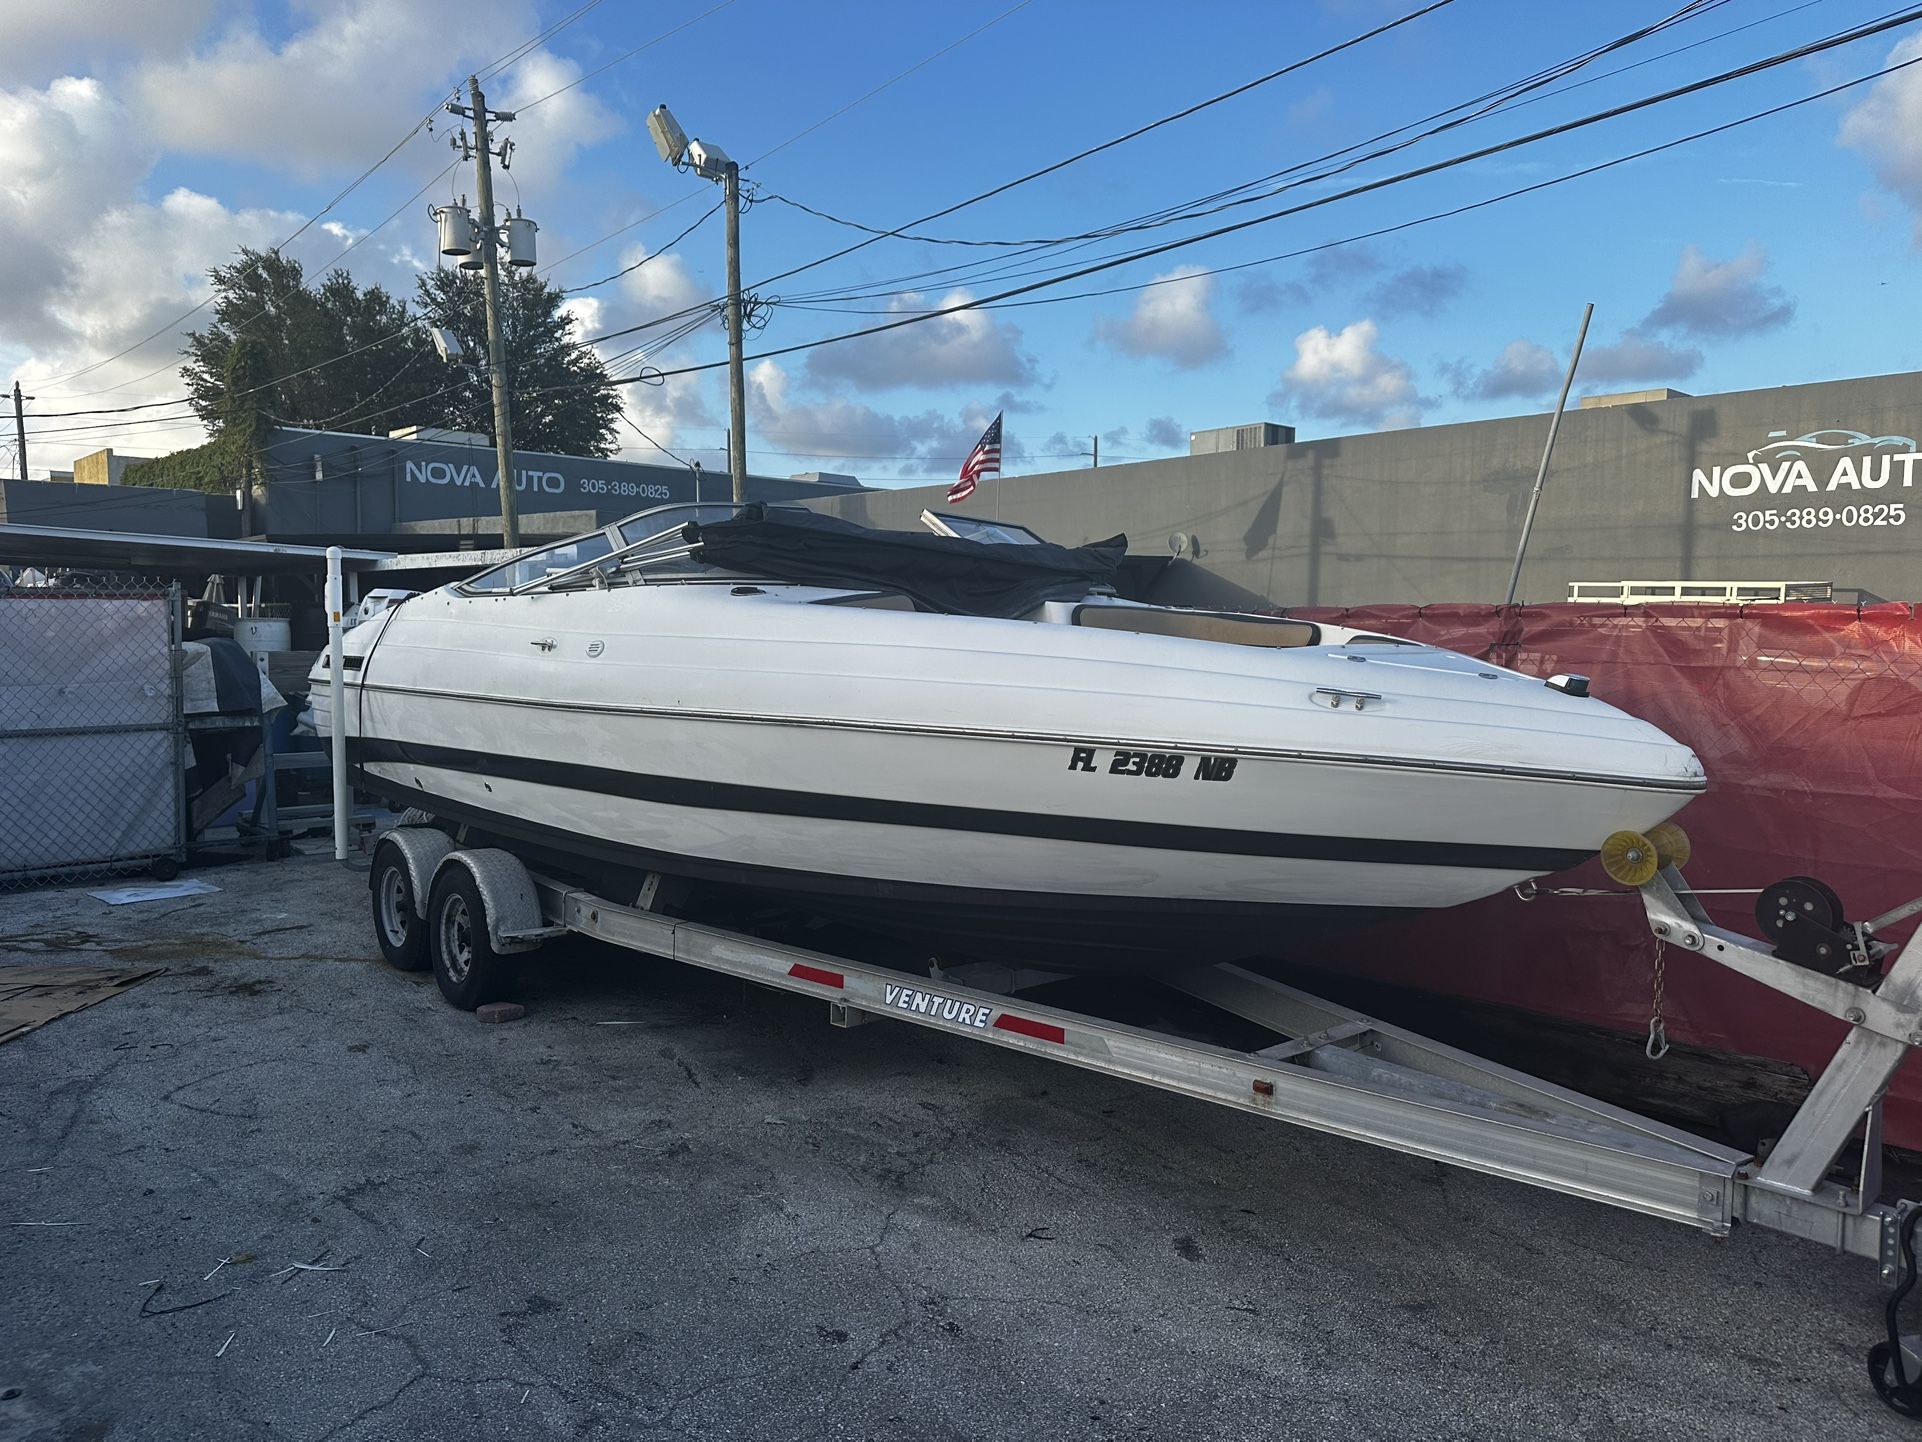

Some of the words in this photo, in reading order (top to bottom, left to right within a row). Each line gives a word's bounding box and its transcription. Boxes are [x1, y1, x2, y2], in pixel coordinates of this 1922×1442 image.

[405, 460, 486, 488] NOVA
[1690, 460, 1818, 499] NOVA
[1068, 747, 1097, 773] FL
[1109, 750, 1185, 779] 2388
[1193, 757, 1238, 781] NB
[884, 983, 992, 1029] VENTURE
